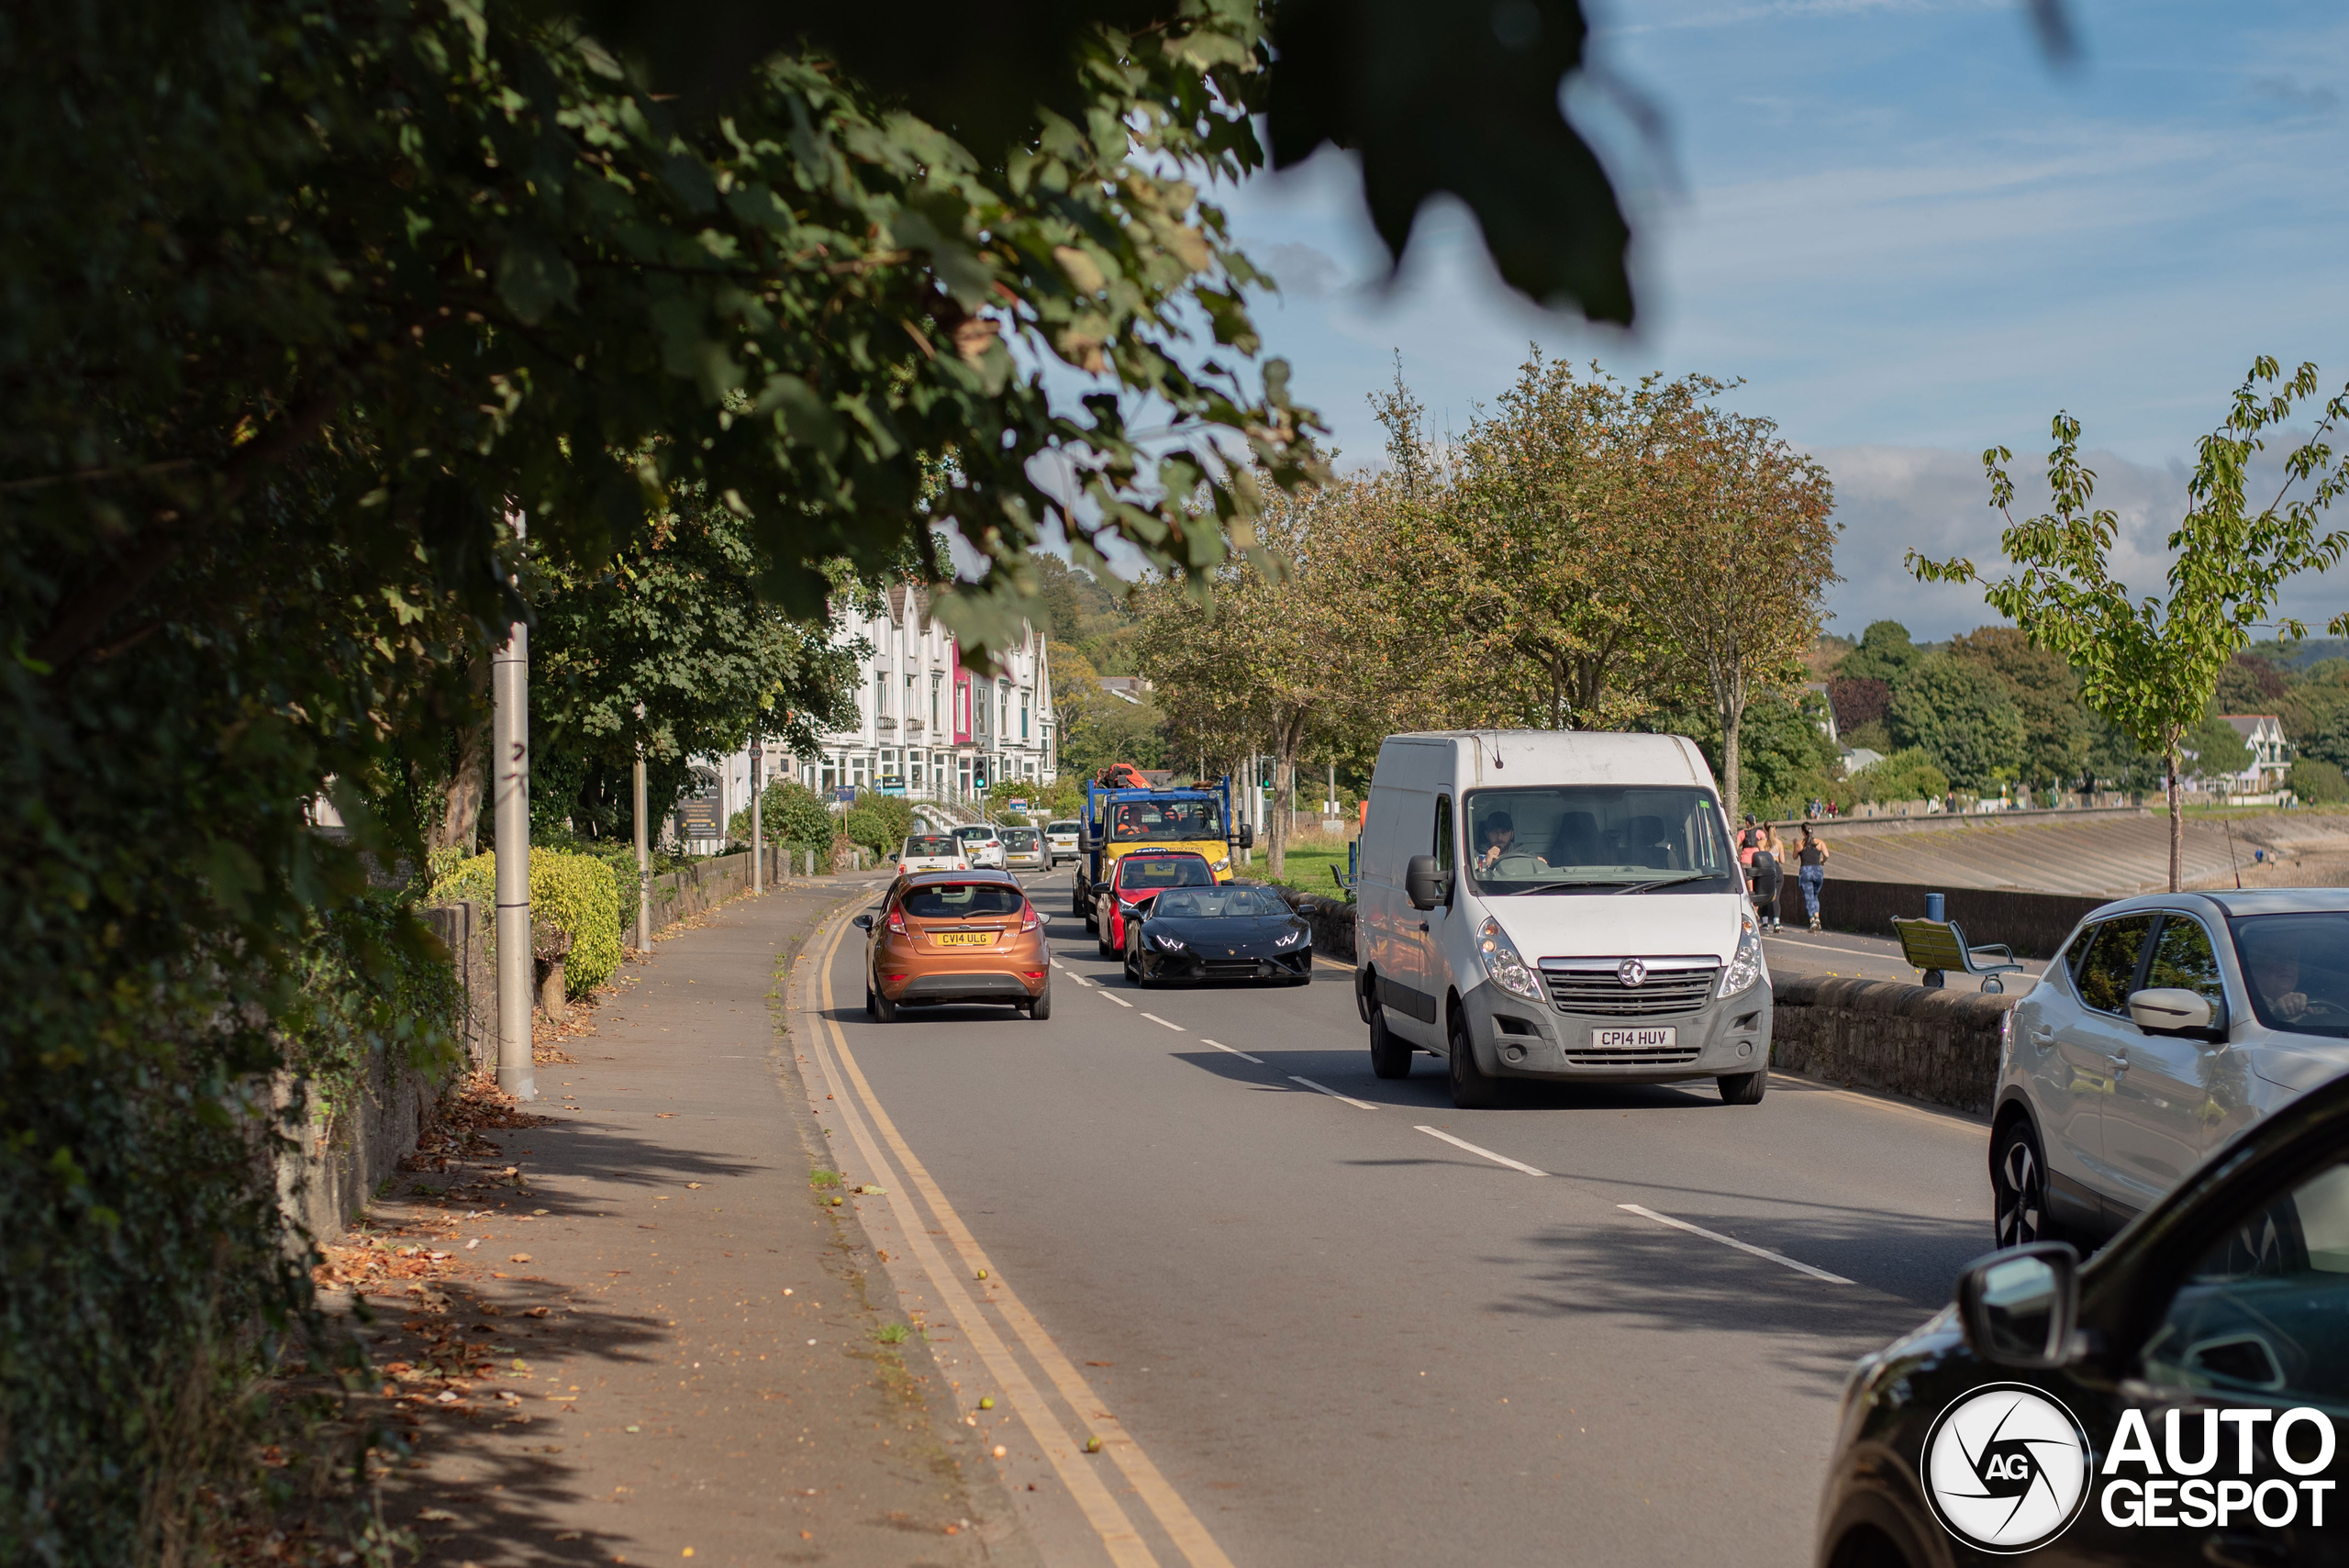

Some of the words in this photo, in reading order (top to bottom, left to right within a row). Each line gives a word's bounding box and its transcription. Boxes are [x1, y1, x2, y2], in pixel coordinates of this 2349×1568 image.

[942, 934, 964, 943] CV14
[967, 934, 986, 942] ULG
[1601, 1031, 1633, 1045] CP14
[1638, 1030, 1666, 1044] HUV
